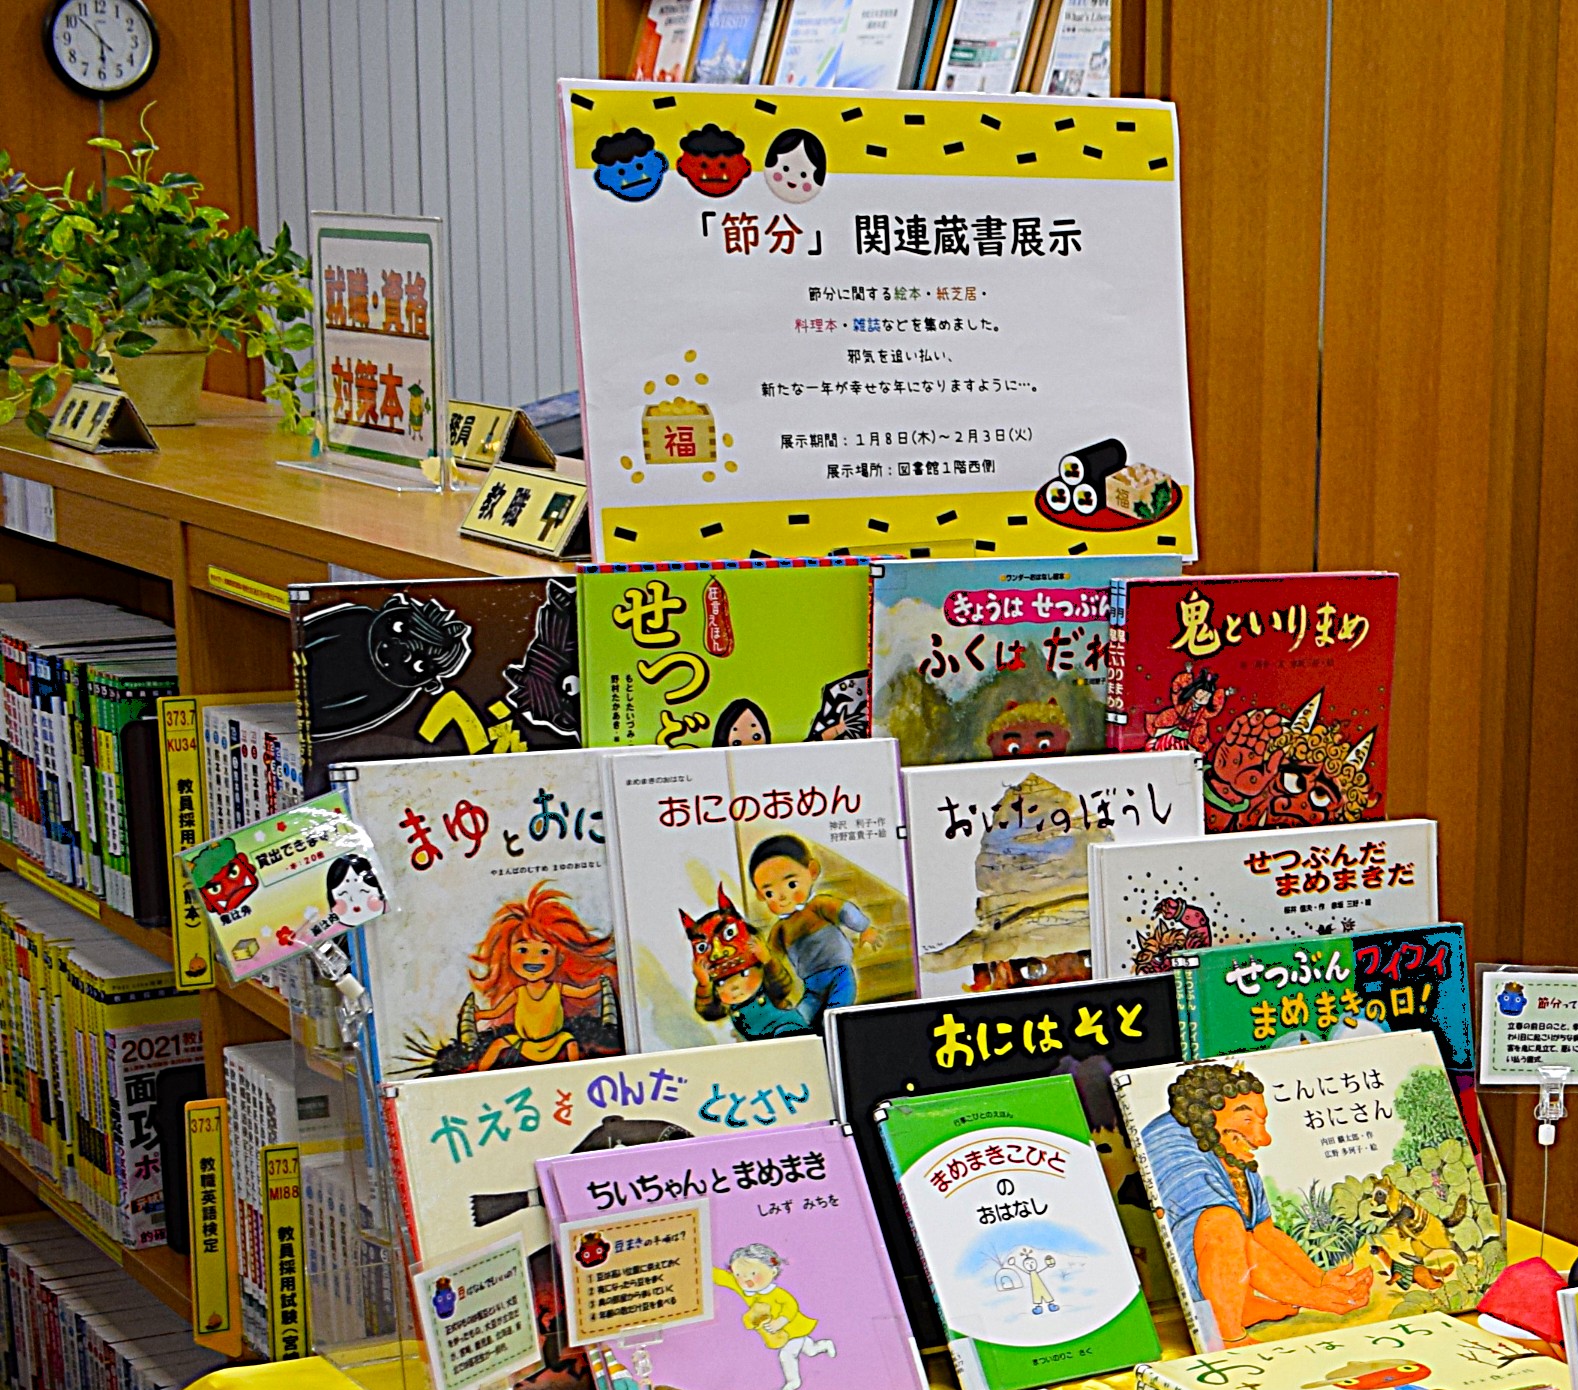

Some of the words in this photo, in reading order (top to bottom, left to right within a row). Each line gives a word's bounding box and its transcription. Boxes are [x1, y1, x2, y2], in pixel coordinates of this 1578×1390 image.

[953, 592, 1023, 624] きょうは
[658, 785, 860, 828] おにのおめん
[1244, 841, 1387, 874] せつぶんだ
[1275, 862, 1416, 897] まめまきだ
[1227, 949, 1351, 988] せつぶん
[122, 1034, 182, 1063] 2021
[1273, 1070, 1383, 1105] こんにちは
[430, 1087, 541, 1163] かえる
[1304, 1099, 1394, 1132] おにさん
[996, 1178, 1015, 1195] の
[976, 1198, 1049, 1225] おはなし
